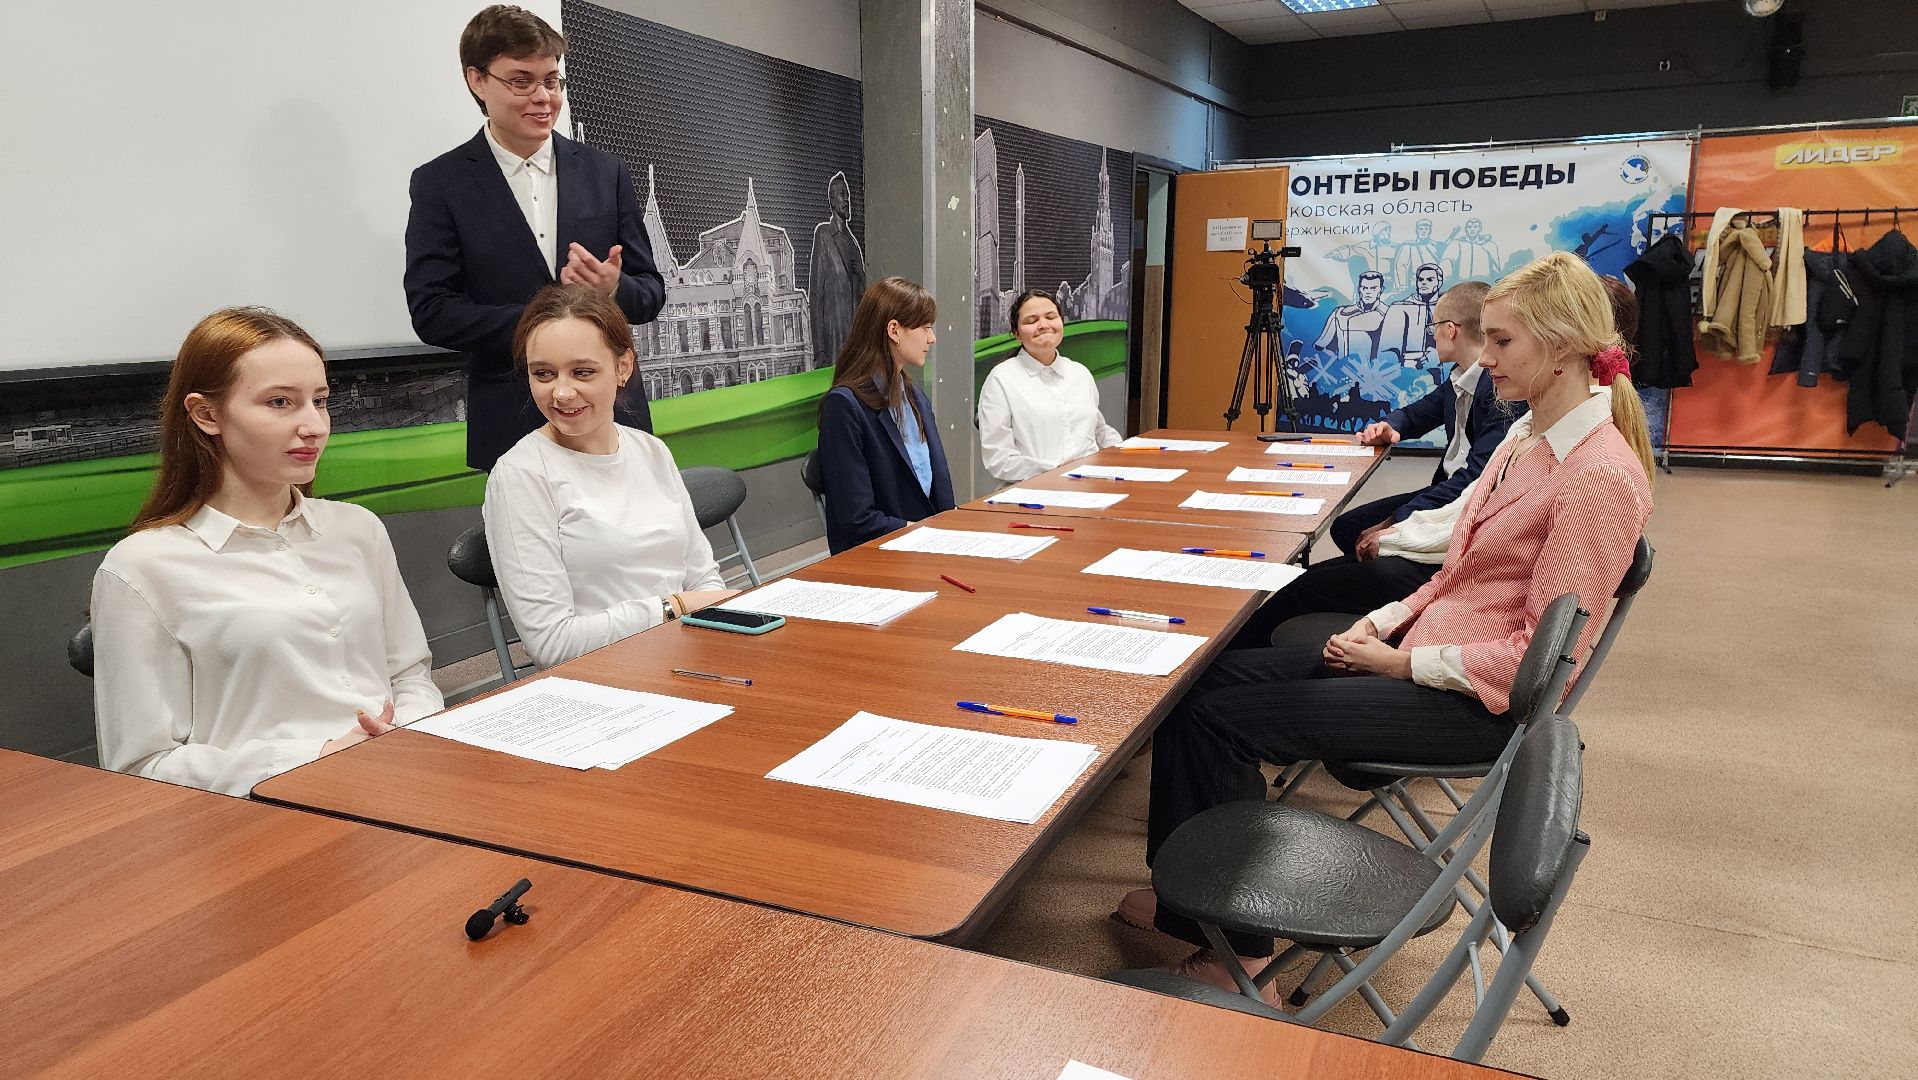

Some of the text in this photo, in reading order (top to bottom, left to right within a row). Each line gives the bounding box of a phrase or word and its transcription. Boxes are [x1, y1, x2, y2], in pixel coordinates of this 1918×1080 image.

[1781, 144, 1896, 164] ЛИДЕР
[1291, 163, 1575, 196] ОНТЁРЫ ПОБЕДЫ
[1290, 198, 1473, 218] ковская область
